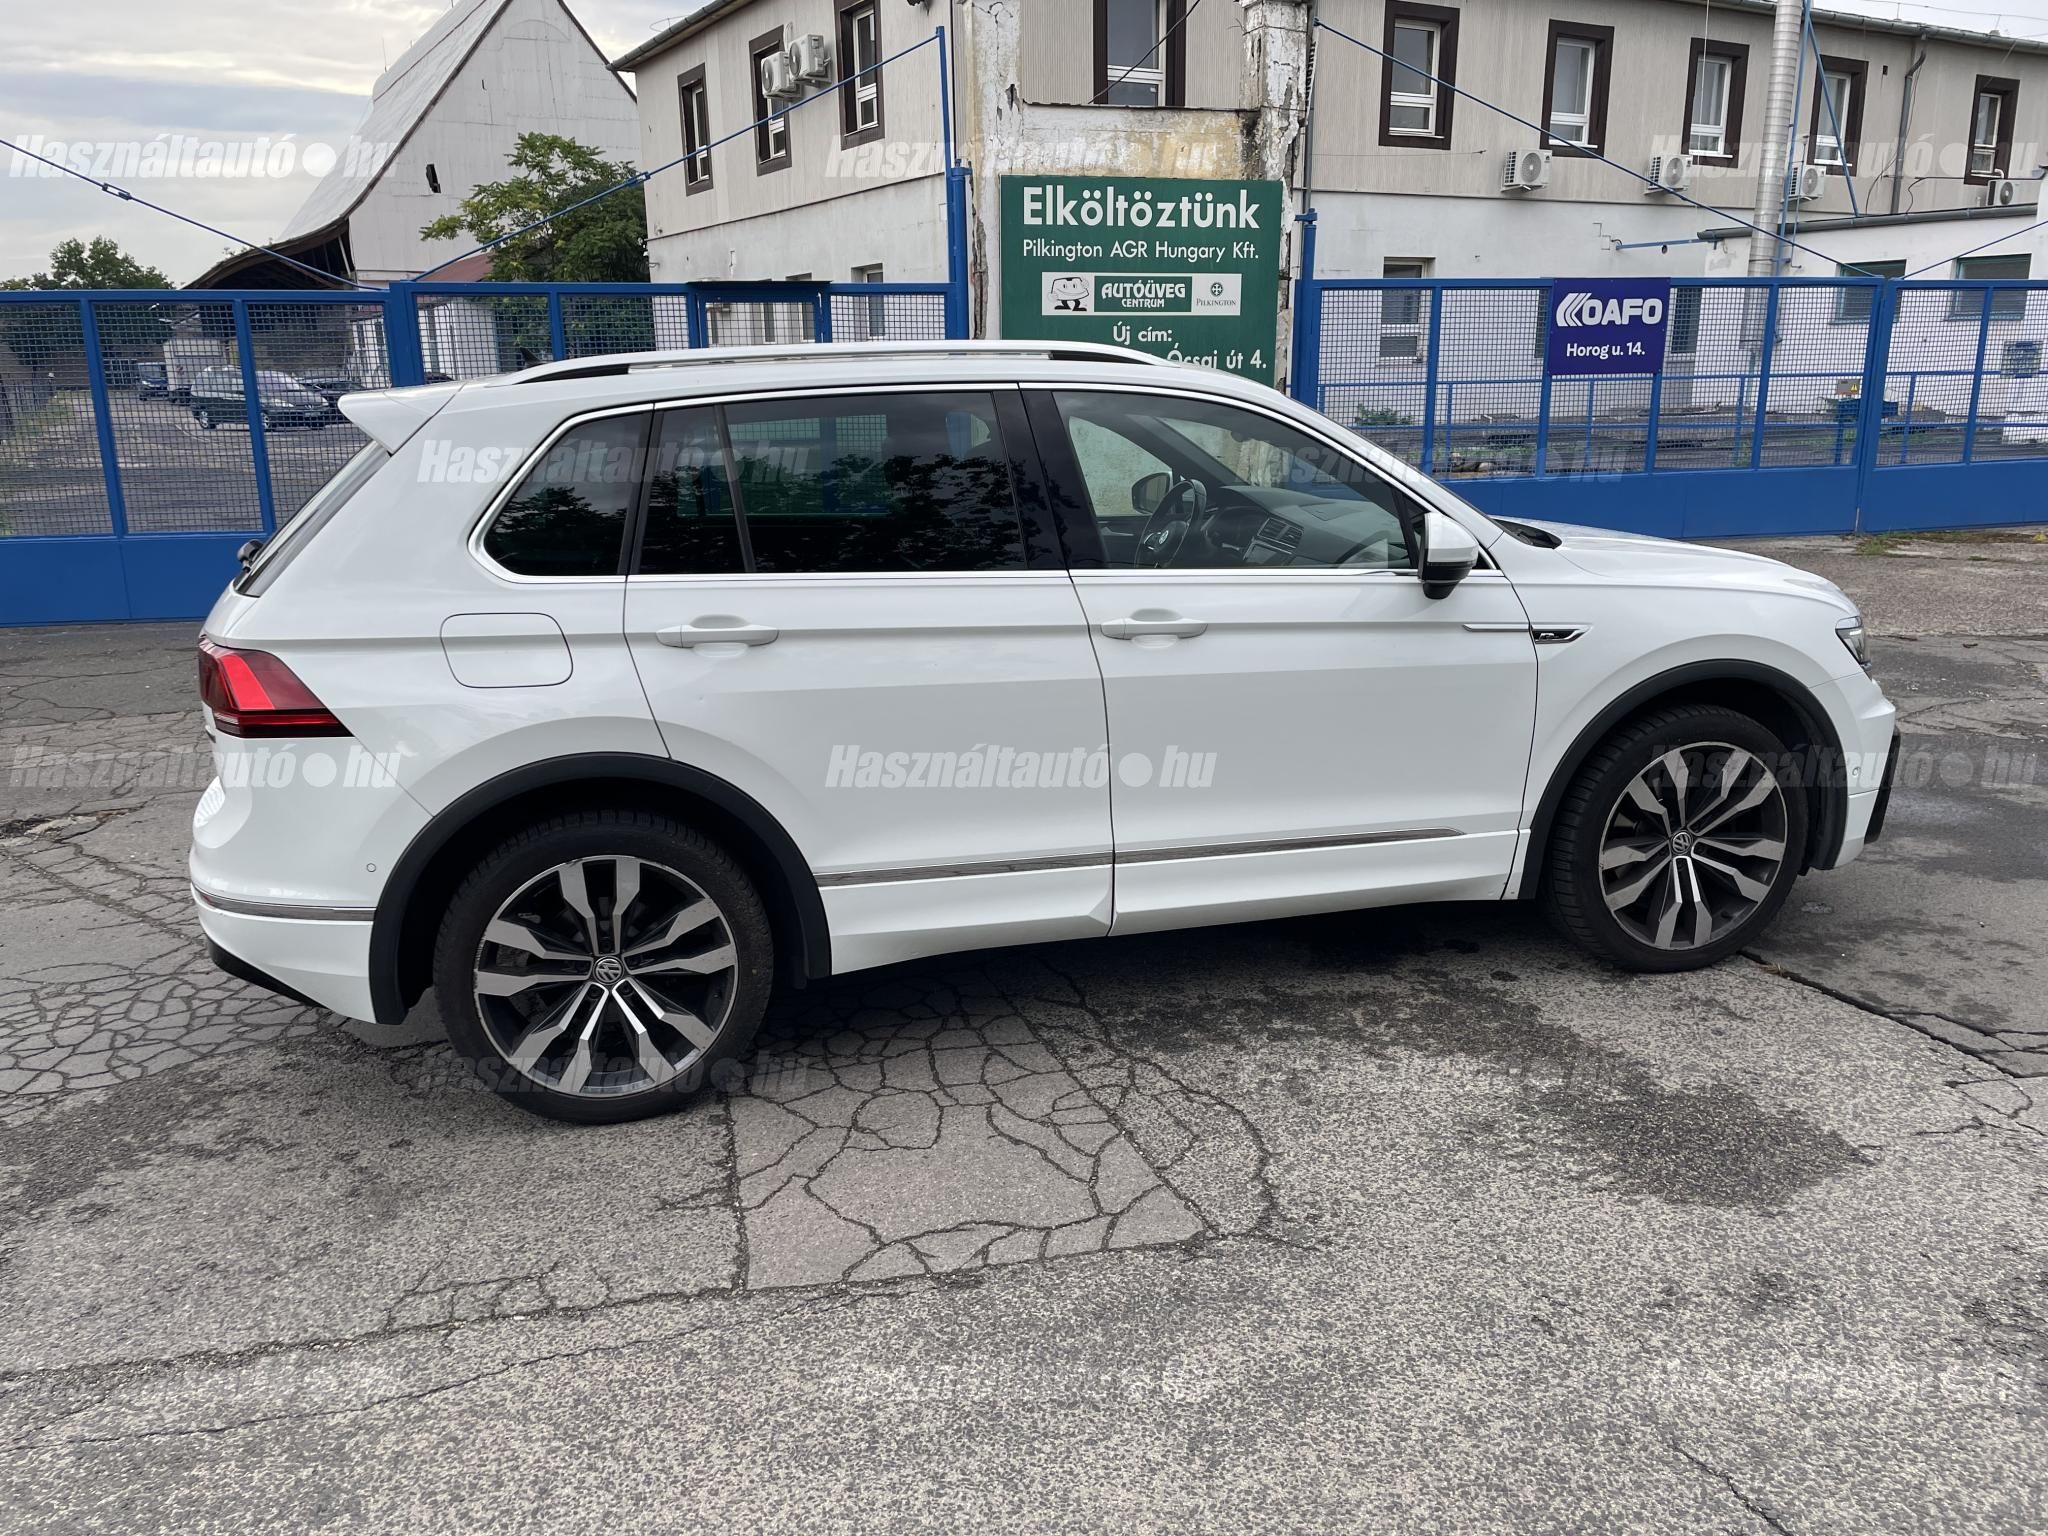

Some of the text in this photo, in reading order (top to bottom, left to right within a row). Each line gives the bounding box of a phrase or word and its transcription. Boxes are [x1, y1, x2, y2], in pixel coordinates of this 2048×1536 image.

[1023, 184, 1260, 229] Elköltöztünk
[1023, 239, 1259, 263] Pilkington AGR Hungary Kft.
[1101, 280, 1186, 299] AUTÓÜVEG
[1121, 298, 1165, 308] CENTRUM
[1112, 321, 1172, 345] Új cím:
[1226, 350, 1243, 369] út
[1250, 349, 1267, 369] 4.
[1566, 342, 1645, 360] Horog u. 14.
